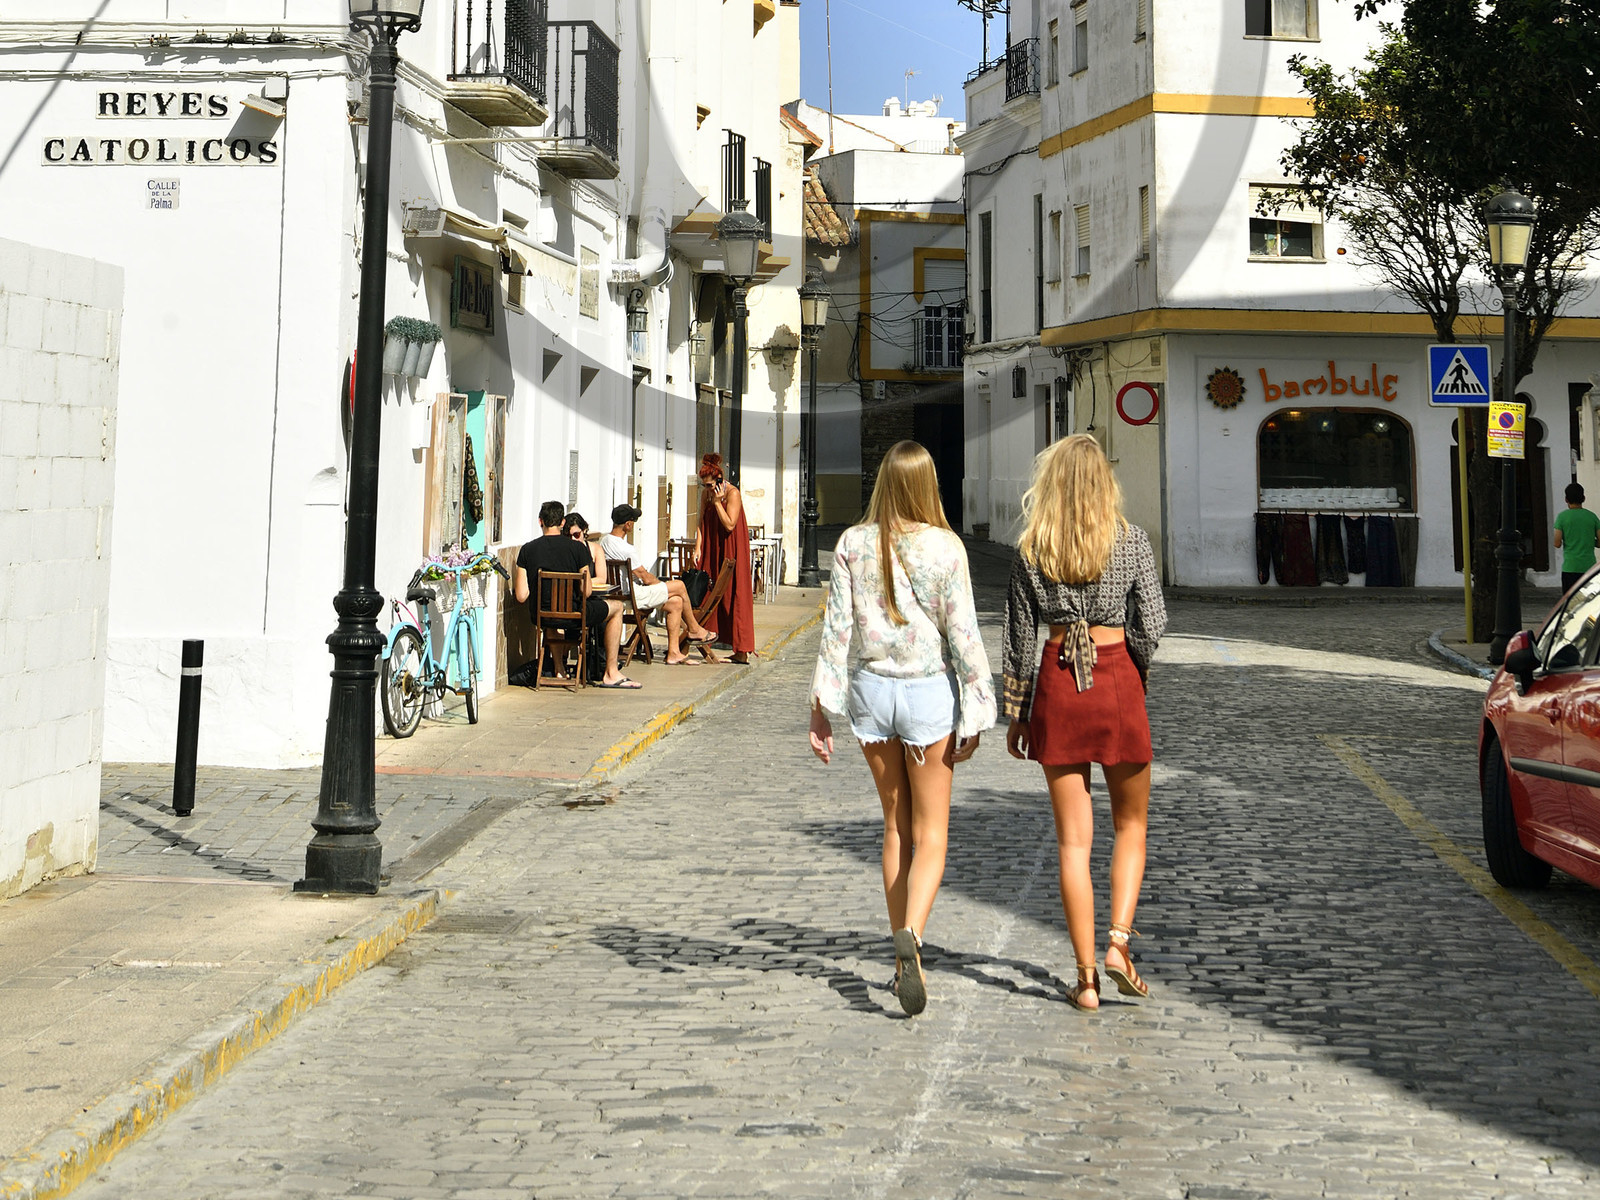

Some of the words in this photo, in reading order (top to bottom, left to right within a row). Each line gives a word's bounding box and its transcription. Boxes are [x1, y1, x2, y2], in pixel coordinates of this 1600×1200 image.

[98, 92, 228, 118] REYES
[44, 138, 278, 164] CATOLICOS
[147, 179, 177, 190] CALLE
[150, 197, 173, 209] Palma
